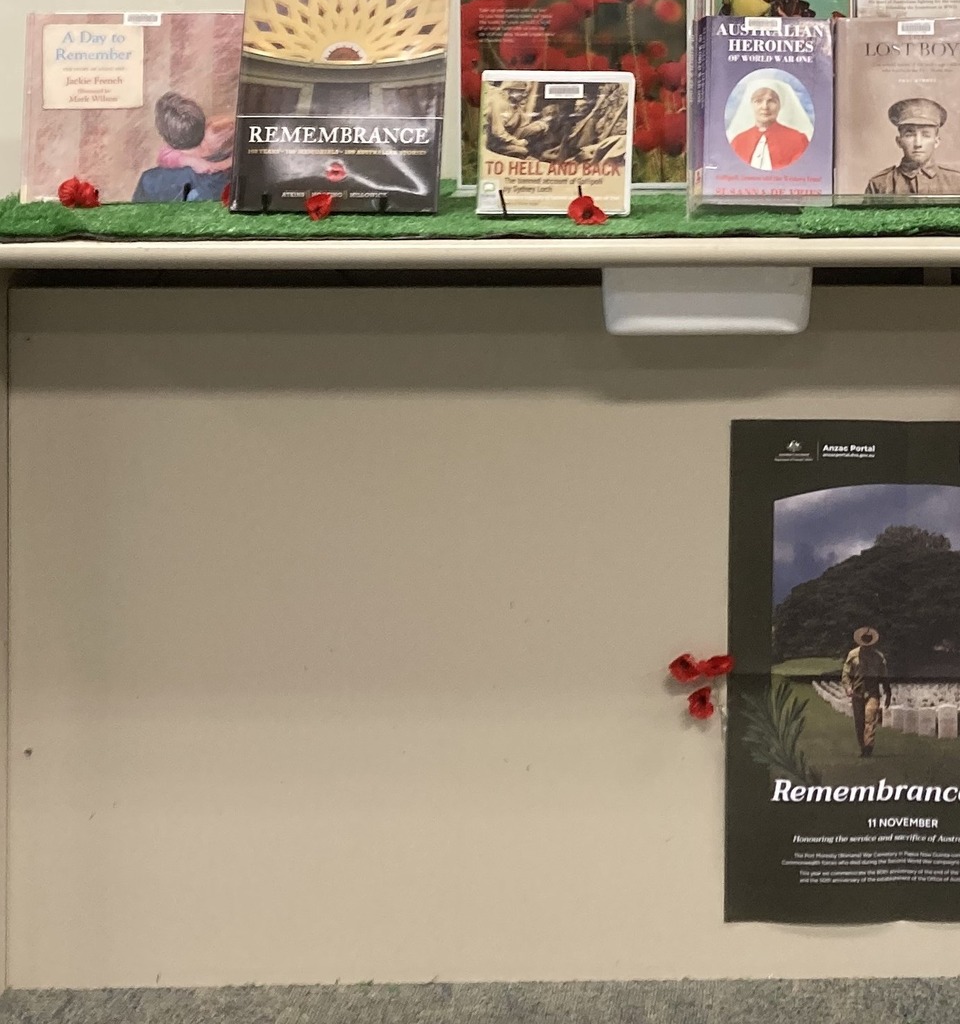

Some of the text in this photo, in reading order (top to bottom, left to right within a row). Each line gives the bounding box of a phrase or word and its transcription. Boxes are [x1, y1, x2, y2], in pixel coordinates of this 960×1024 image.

[62, 30, 126, 45] A Day to
[728, 38, 814, 53] HEROINES
[865, 42, 914, 56] LOST
[55, 48, 132, 60] Remember
[742, 54, 773, 62] WORLD
[775, 55, 794, 63] WAR
[66, 76, 123, 86] Jackie French
[248, 126, 430, 144] REMEMBRANCE
[485, 160, 621, 176] TO HELL AND BACK
[867, 818, 938, 829] 11 NOVEMBER
[792, 834, 834, 844] Honouring
[835, 834, 848, 842] the
[850, 834, 876, 842] service
[878, 834, 893, 842] and
[894, 834, 926, 842] sacrifice
[927, 834, 936, 842] of
